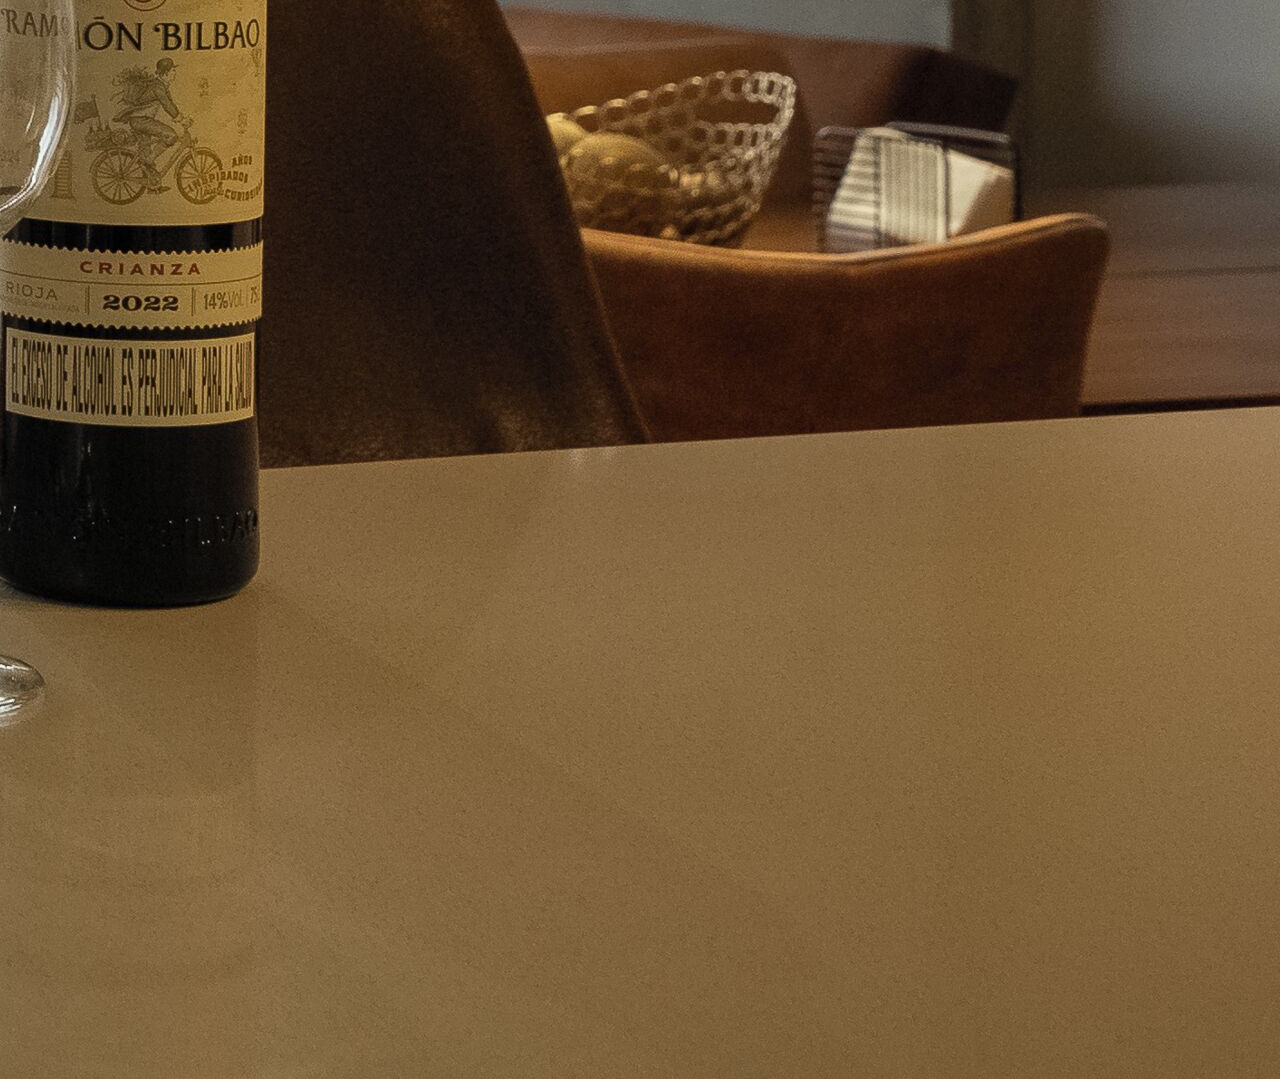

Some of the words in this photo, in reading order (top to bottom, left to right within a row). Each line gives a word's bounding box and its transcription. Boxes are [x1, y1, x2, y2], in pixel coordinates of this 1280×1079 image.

[154, 18, 260, 51] BILBAO
[79, 260, 202, 276] CRIANZA
[5, 281, 58, 301] RIOJA
[103, 294, 179, 312] 2022
[11, 338, 19, 404] EL
[22, 339, 52, 410] EXCESO
[56, 344, 68, 412] DE
[72, 345, 117, 416] ALCOHOL
[122, 347, 134, 417] ES
[138, 348, 198, 417] PERJUDICIAL
[201, 345, 223, 415] PARA
